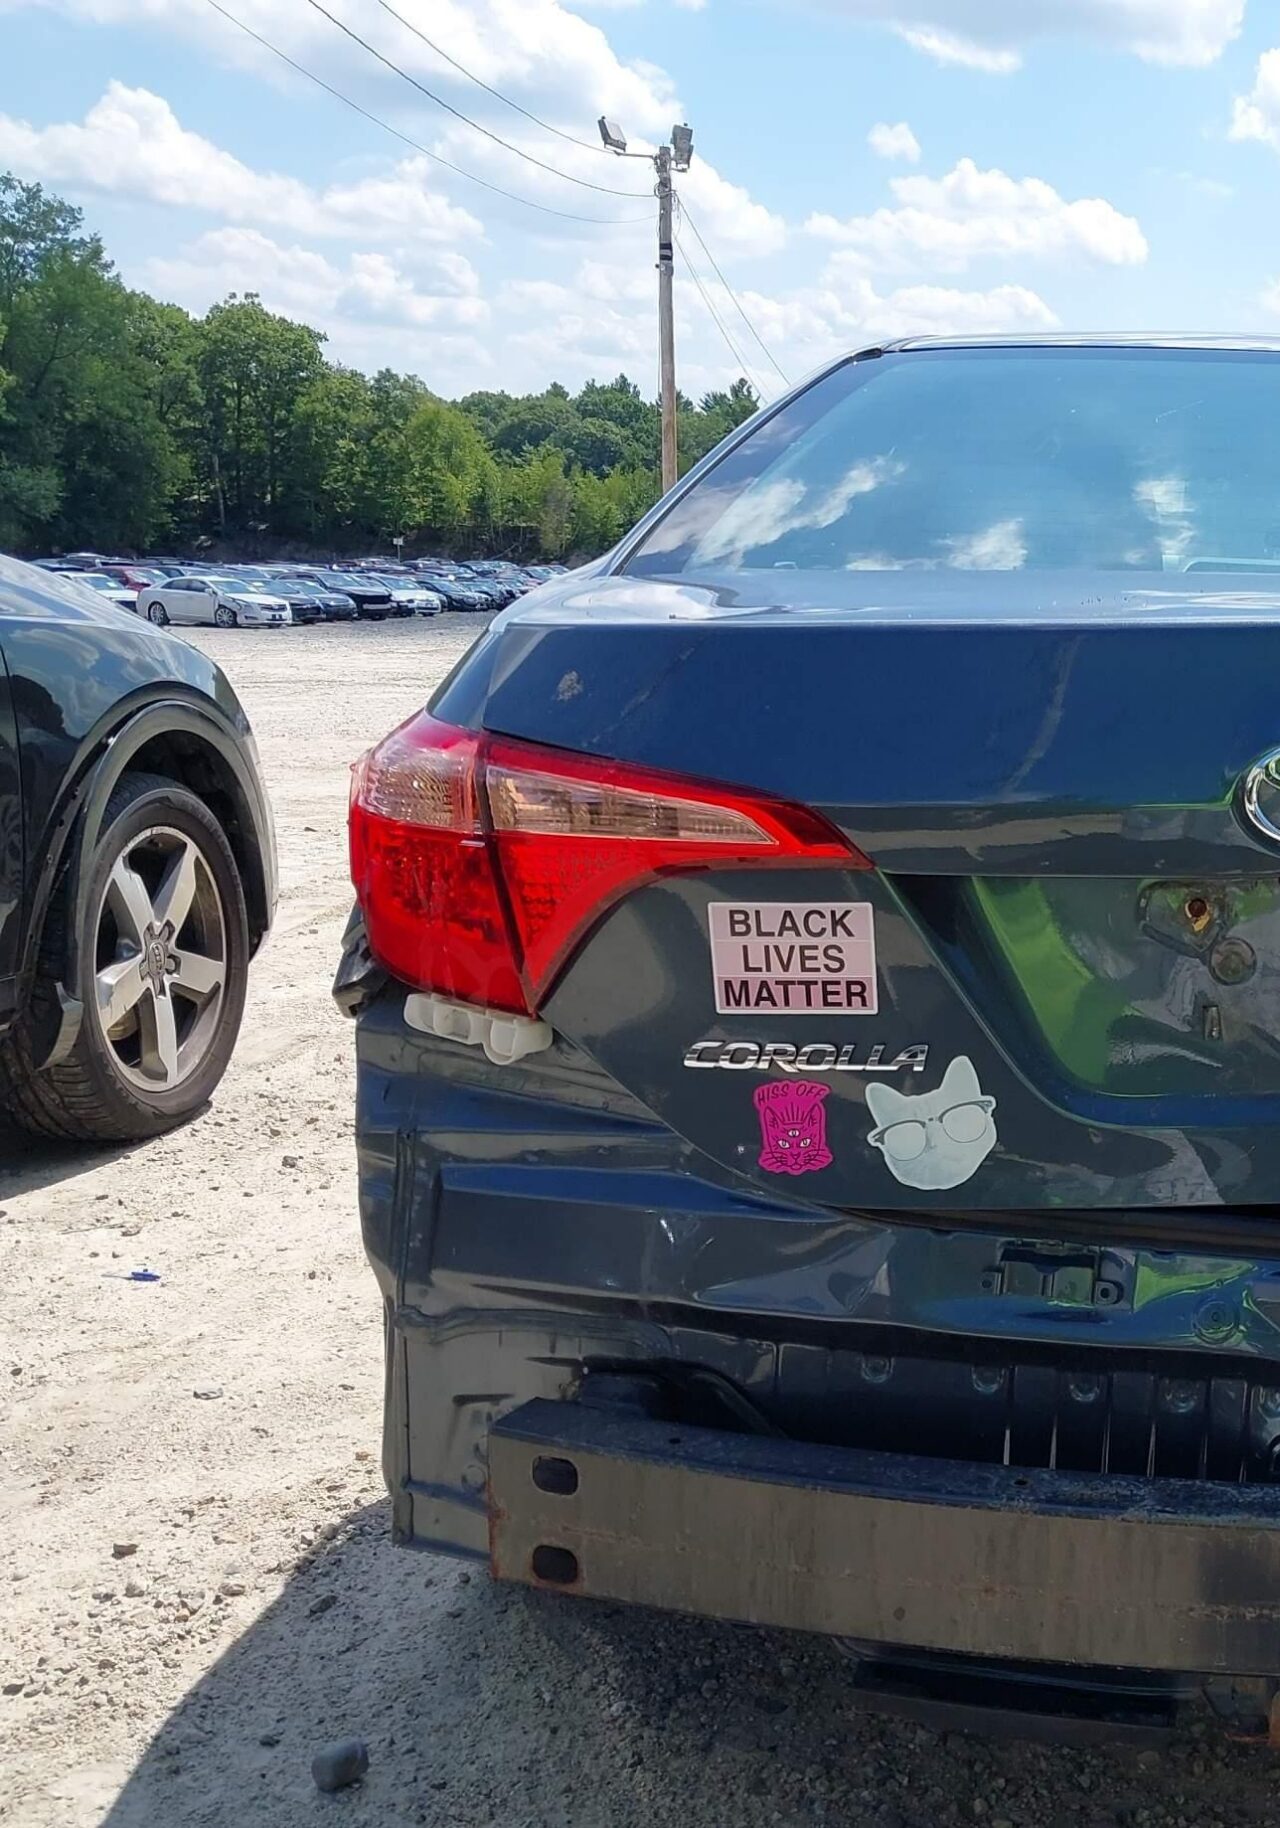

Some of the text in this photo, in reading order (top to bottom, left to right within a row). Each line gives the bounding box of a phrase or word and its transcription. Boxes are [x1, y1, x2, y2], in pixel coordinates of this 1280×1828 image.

[728, 909, 855, 938] BLACK
[741, 944, 846, 974] LIVES
[723, 979, 869, 1008] MATTER
[683, 1040, 930, 1073] COROLLA
[757, 1083, 827, 1106] HISS OFF
